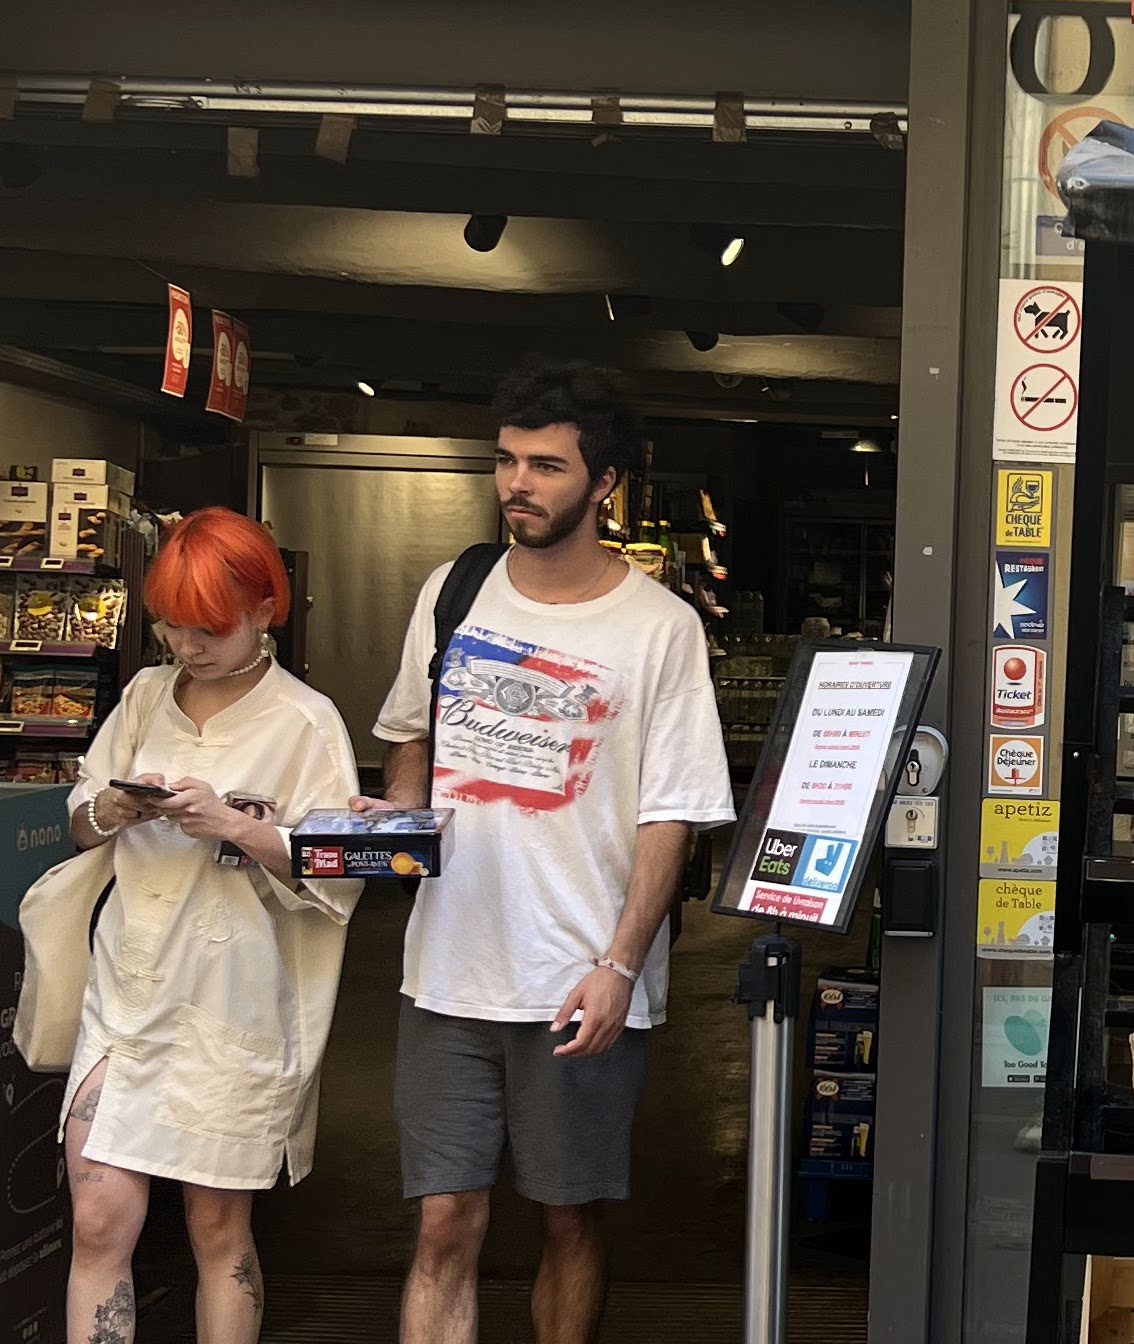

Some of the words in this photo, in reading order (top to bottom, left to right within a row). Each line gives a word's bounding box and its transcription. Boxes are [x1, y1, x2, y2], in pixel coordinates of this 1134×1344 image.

[1013, 526, 1043, 538] TABLE
[997, 689, 1032, 700] Ticket
[439, 695, 572, 753] Budweiser
[994, 802, 1052, 819] apetiz
[765, 837, 798, 857] Uber
[759, 856, 791, 875] Eats
[755, 890, 781, 902] Service
[782, 894, 793, 904] de
[996, 882, 1043, 898] chèque
[995, 898, 1009, 908] de
[1011, 898, 1042, 909] Table
[1003, 1060, 1016, 1068] Too
[1017, 1060, 1038, 1068] Good
